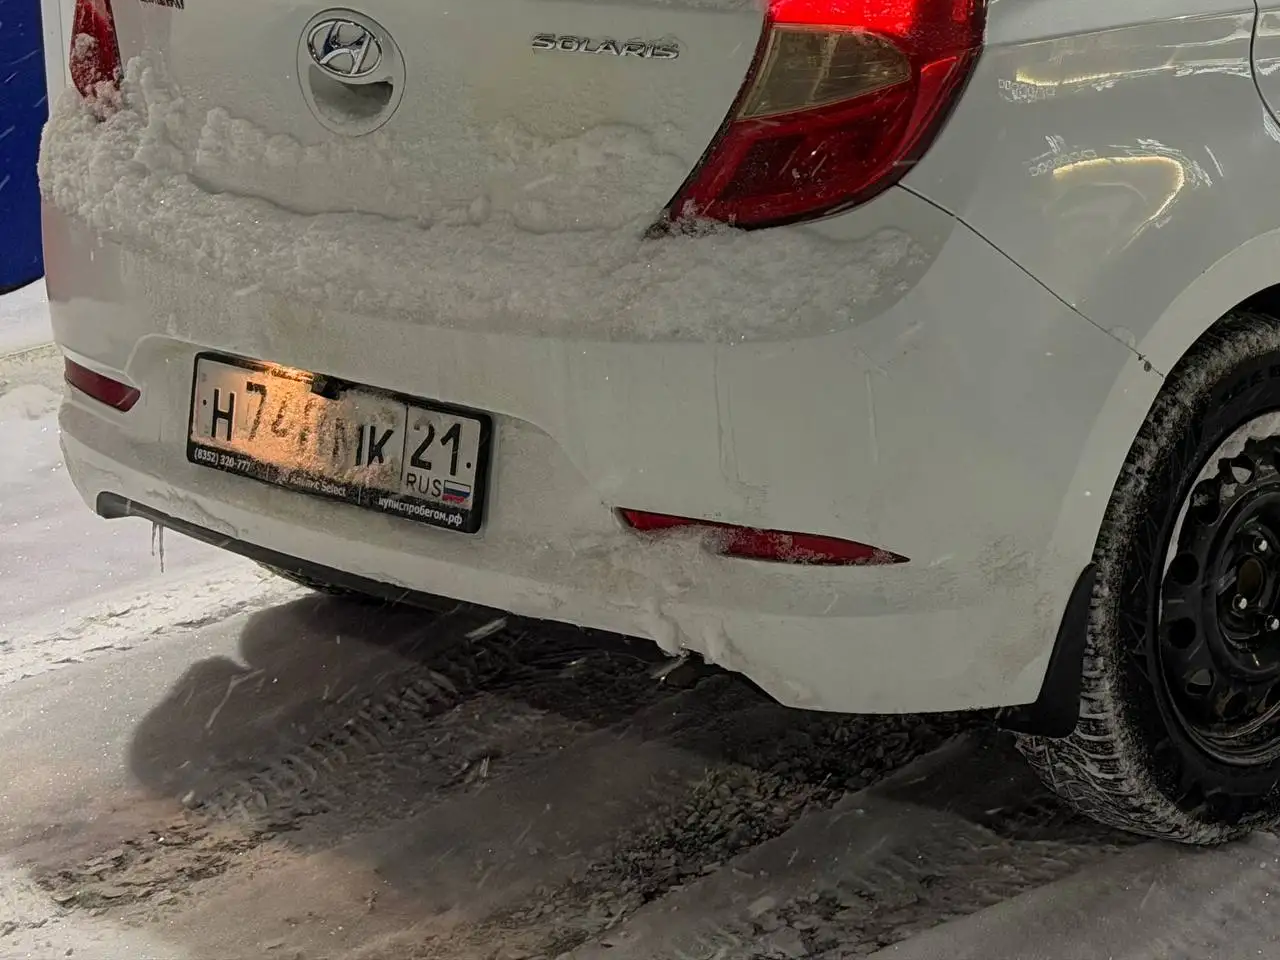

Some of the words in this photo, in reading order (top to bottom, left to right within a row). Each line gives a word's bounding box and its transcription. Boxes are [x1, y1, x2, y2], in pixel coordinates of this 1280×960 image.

[531, 33, 680, 59] SOLARIS
[193, 447, 219, 466] (8352)
[410, 421, 462, 476] 21
[320, 480, 346, 497] Select
[405, 472, 442, 498] RUS
